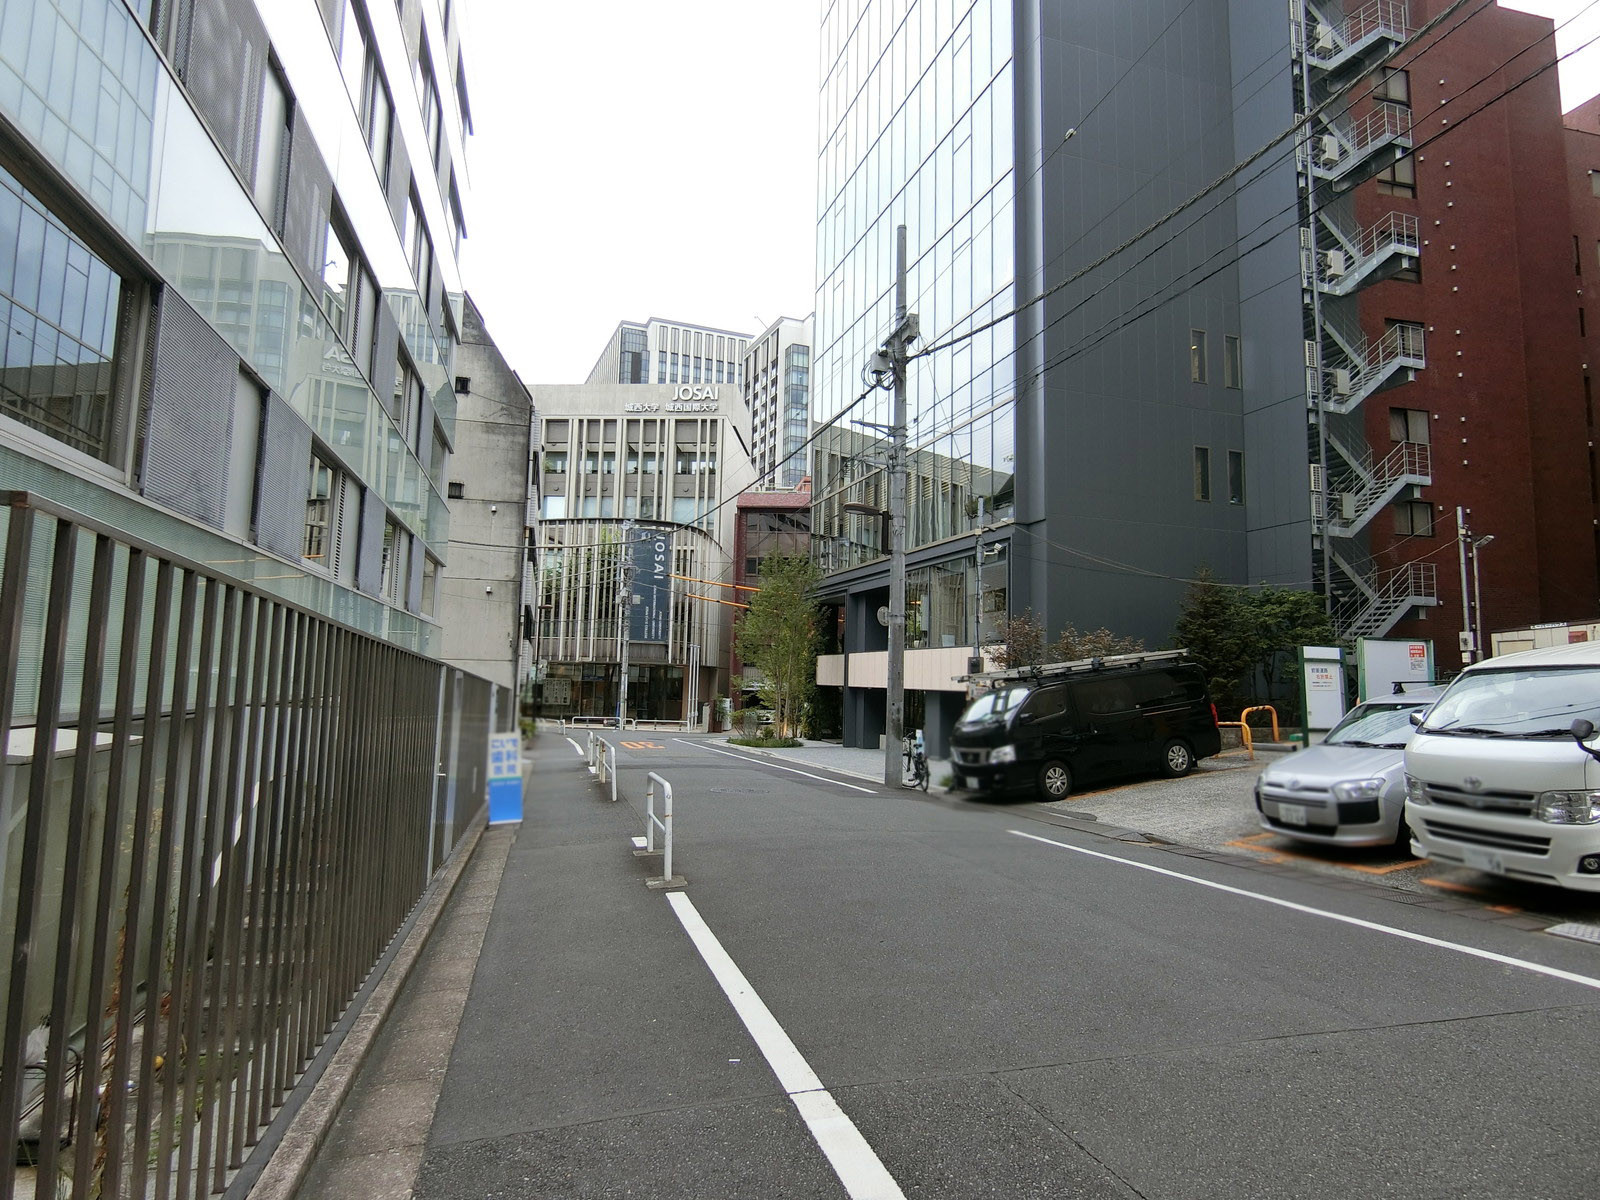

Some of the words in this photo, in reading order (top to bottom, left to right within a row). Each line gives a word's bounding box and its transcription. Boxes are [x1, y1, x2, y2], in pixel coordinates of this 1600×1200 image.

[672, 386, 719, 401] JOSAI
[624, 402, 660, 412] 城西大学
[665, 402, 719, 412] 城西国際大学
[654, 535, 666, 579] JOSAI
